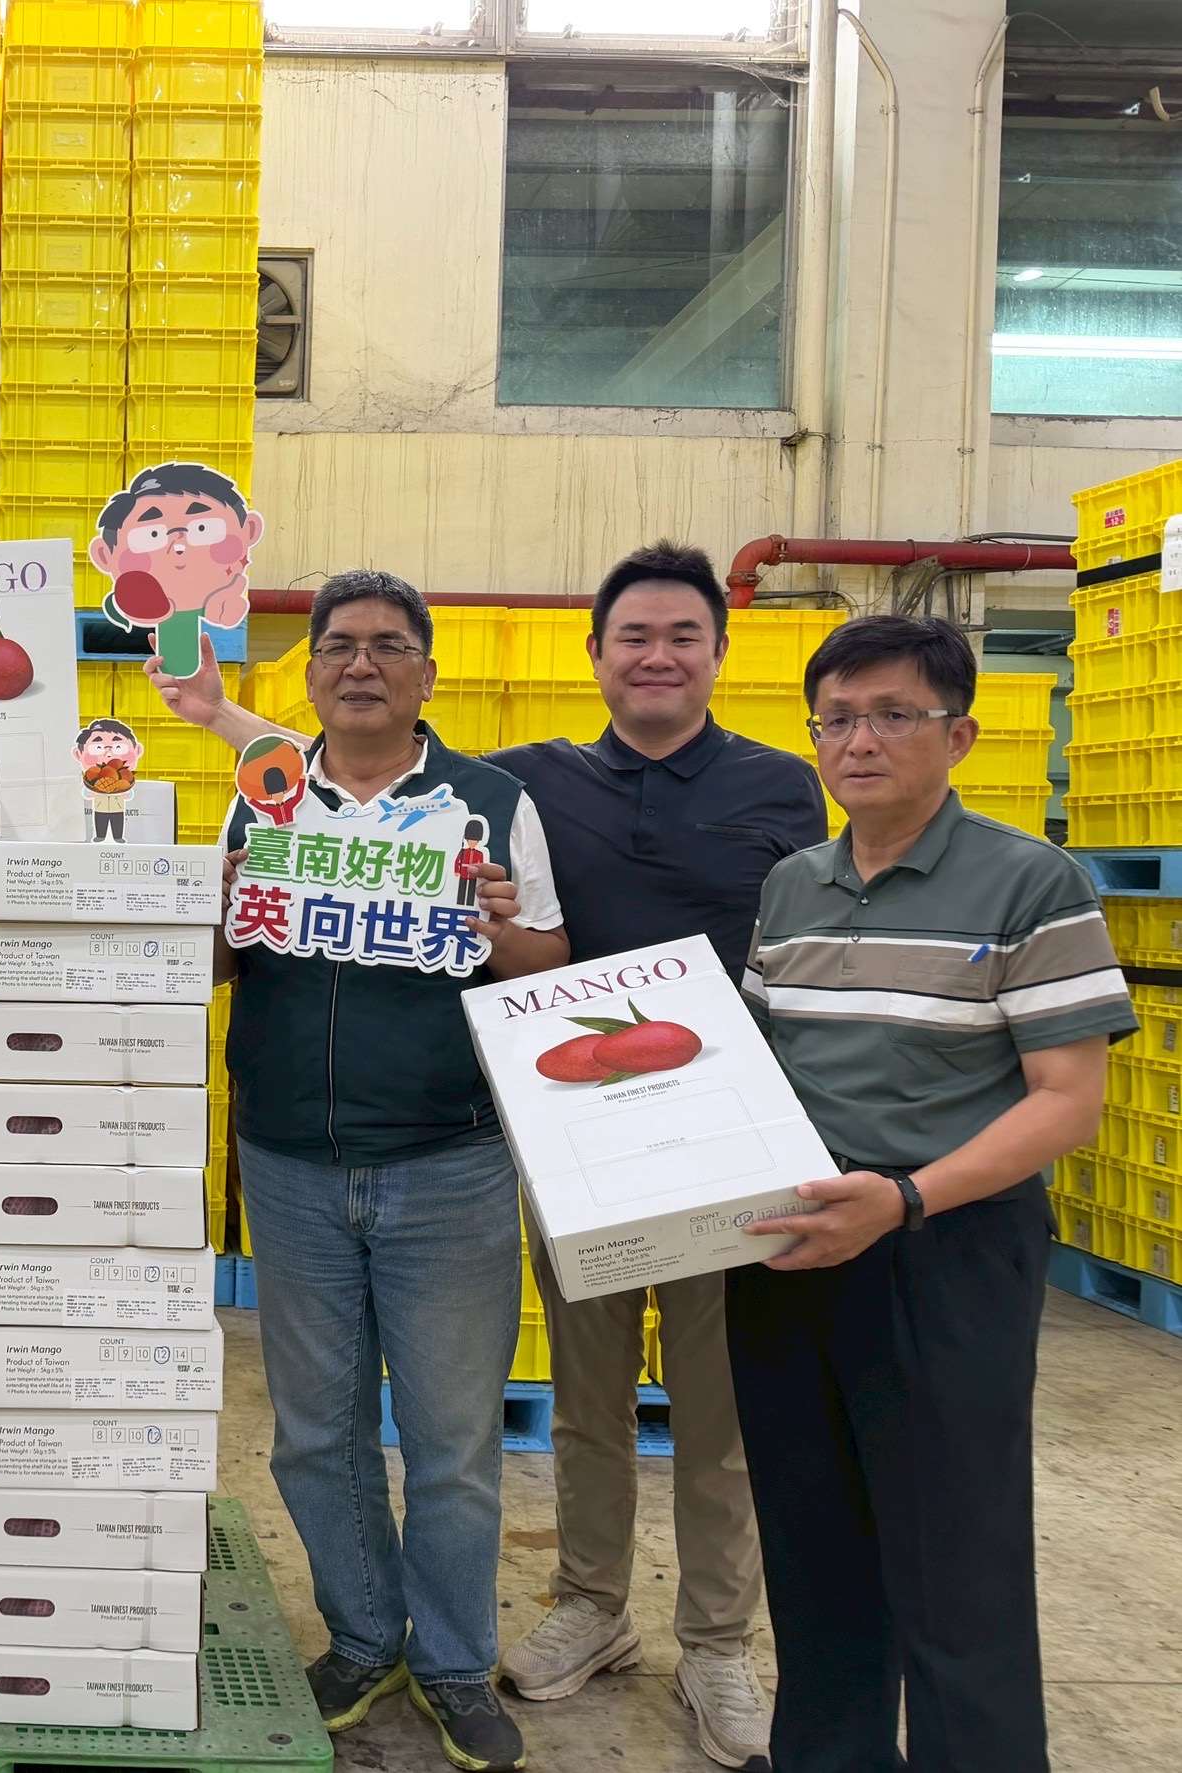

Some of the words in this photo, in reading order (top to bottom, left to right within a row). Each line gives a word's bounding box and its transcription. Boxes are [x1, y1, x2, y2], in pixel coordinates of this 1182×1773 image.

[7, 858, 28, 866] Irwin
[31, 858, 62, 868] Mango
[245, 827, 446, 890] 臺南好物
[104, 861, 110, 871] 8
[123, 861, 128, 871] 9
[137, 861, 148, 872] 10
[175, 864, 185, 873] 14
[6, 870, 33, 878] Product
[36, 870, 42, 878] of
[234, 884, 482, 965] 英向世界
[22, 940, 52, 949] Mango
[498, 957, 688, 1019] MANGO
[603, 1091, 626, 1102] TAIWAN
[627, 1086, 647, 1097] FINEST
[647, 1080, 680, 1092] PRODUCTS
[94, 1200, 113, 1208] TAIWAN
[114, 1201, 130, 1209] FINEST
[132, 1202, 159, 1210] PRODUCTS
[690, 1212, 720, 1223] COUNT
[696, 1224, 703, 1233] 8
[578, 1244, 604, 1255] Irwin
[607, 1236, 645, 1249] Mango
[580, 1254, 612, 1265] Product
[615, 1250, 623, 1258] of
[626, 1245, 656, 1255] Taiwan
[21, 1264, 52, 1273] Mango
[31, 1346, 61, 1355] Mango
[91, 1605, 110, 1613] TAIWAN
[112, 1606, 128, 1614] FINEST
[130, 1606, 156, 1615] PRODUCTS
